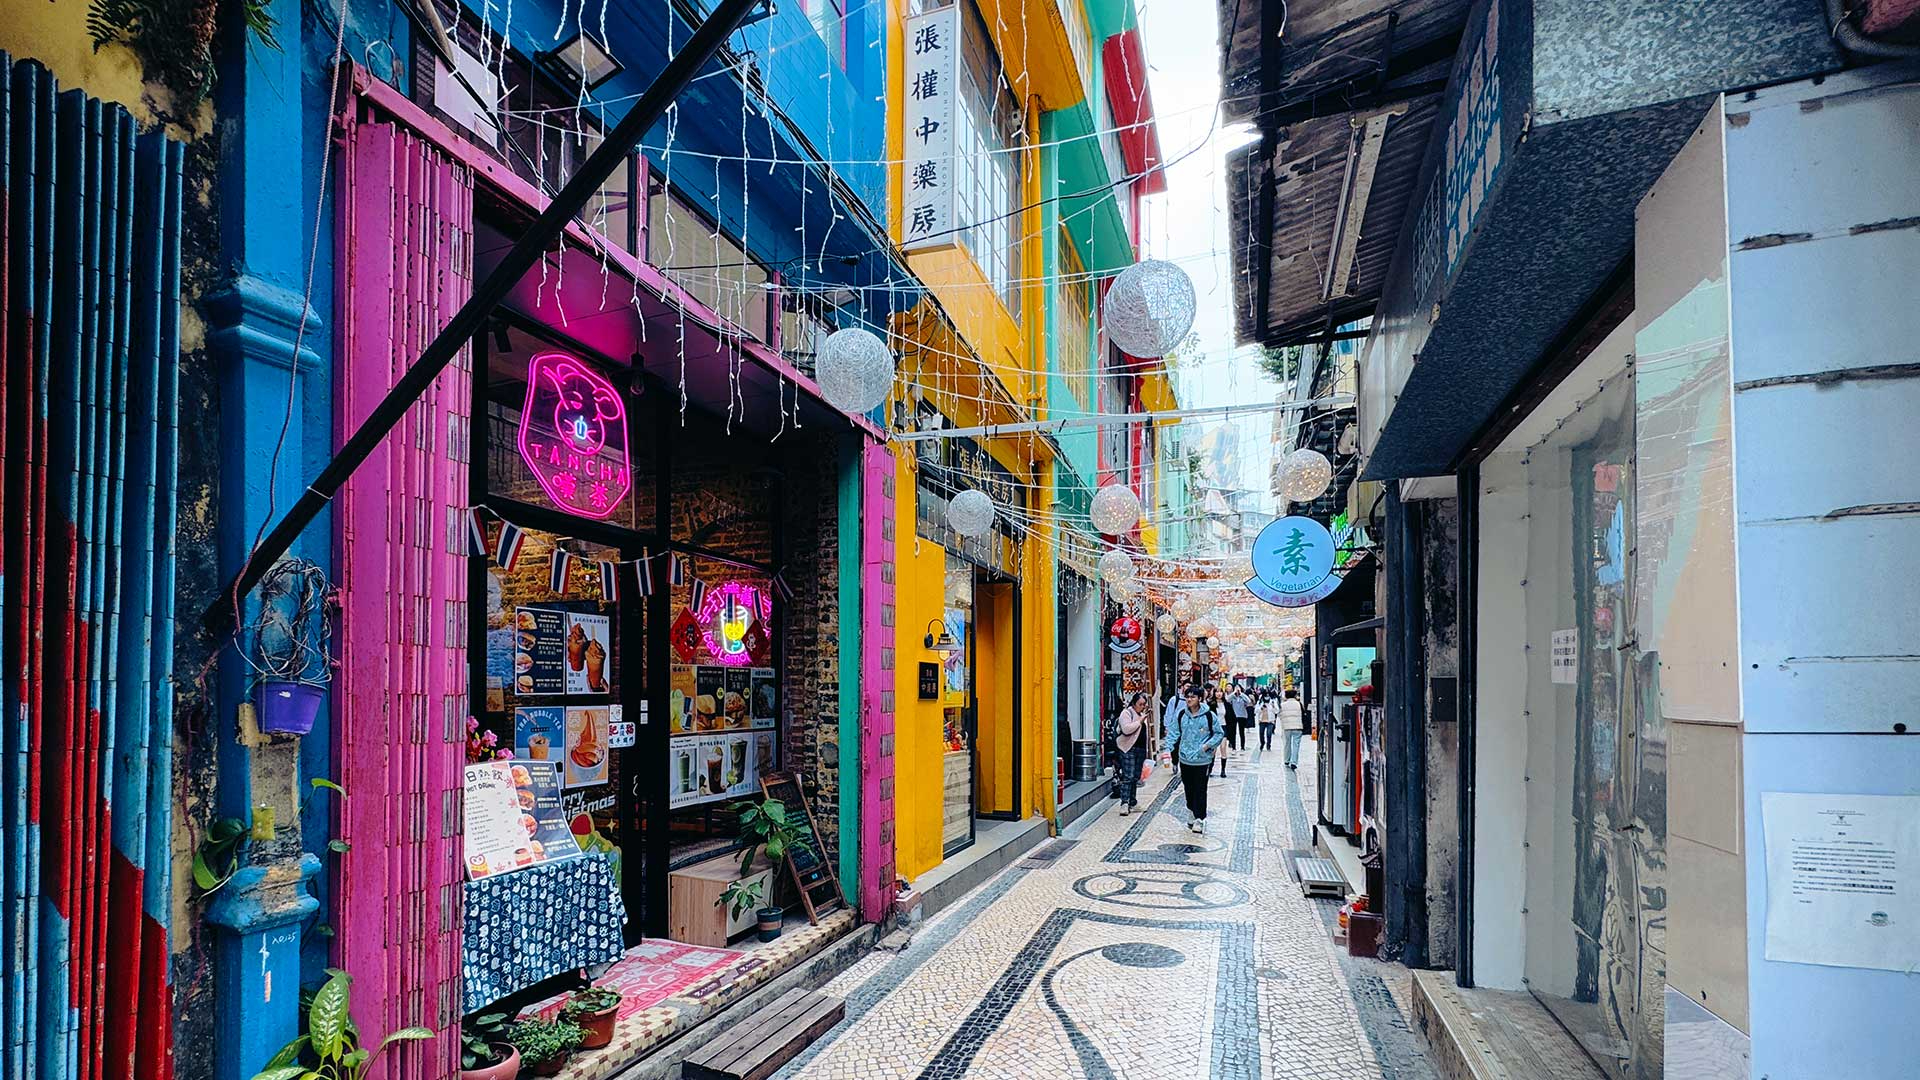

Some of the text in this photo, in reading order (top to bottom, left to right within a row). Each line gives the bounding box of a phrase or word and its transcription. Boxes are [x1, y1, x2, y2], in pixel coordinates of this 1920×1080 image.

[910, 24, 941, 233] 張權中藥房
[530, 443, 626, 486] TANCHA
[1273, 527, 1314, 576] 素
[1270, 575, 1322, 592] Vegetarian
[702, 630, 721, 655] Iced
[552, 717, 563, 731] TEA
[563, 790, 585, 806] rry
